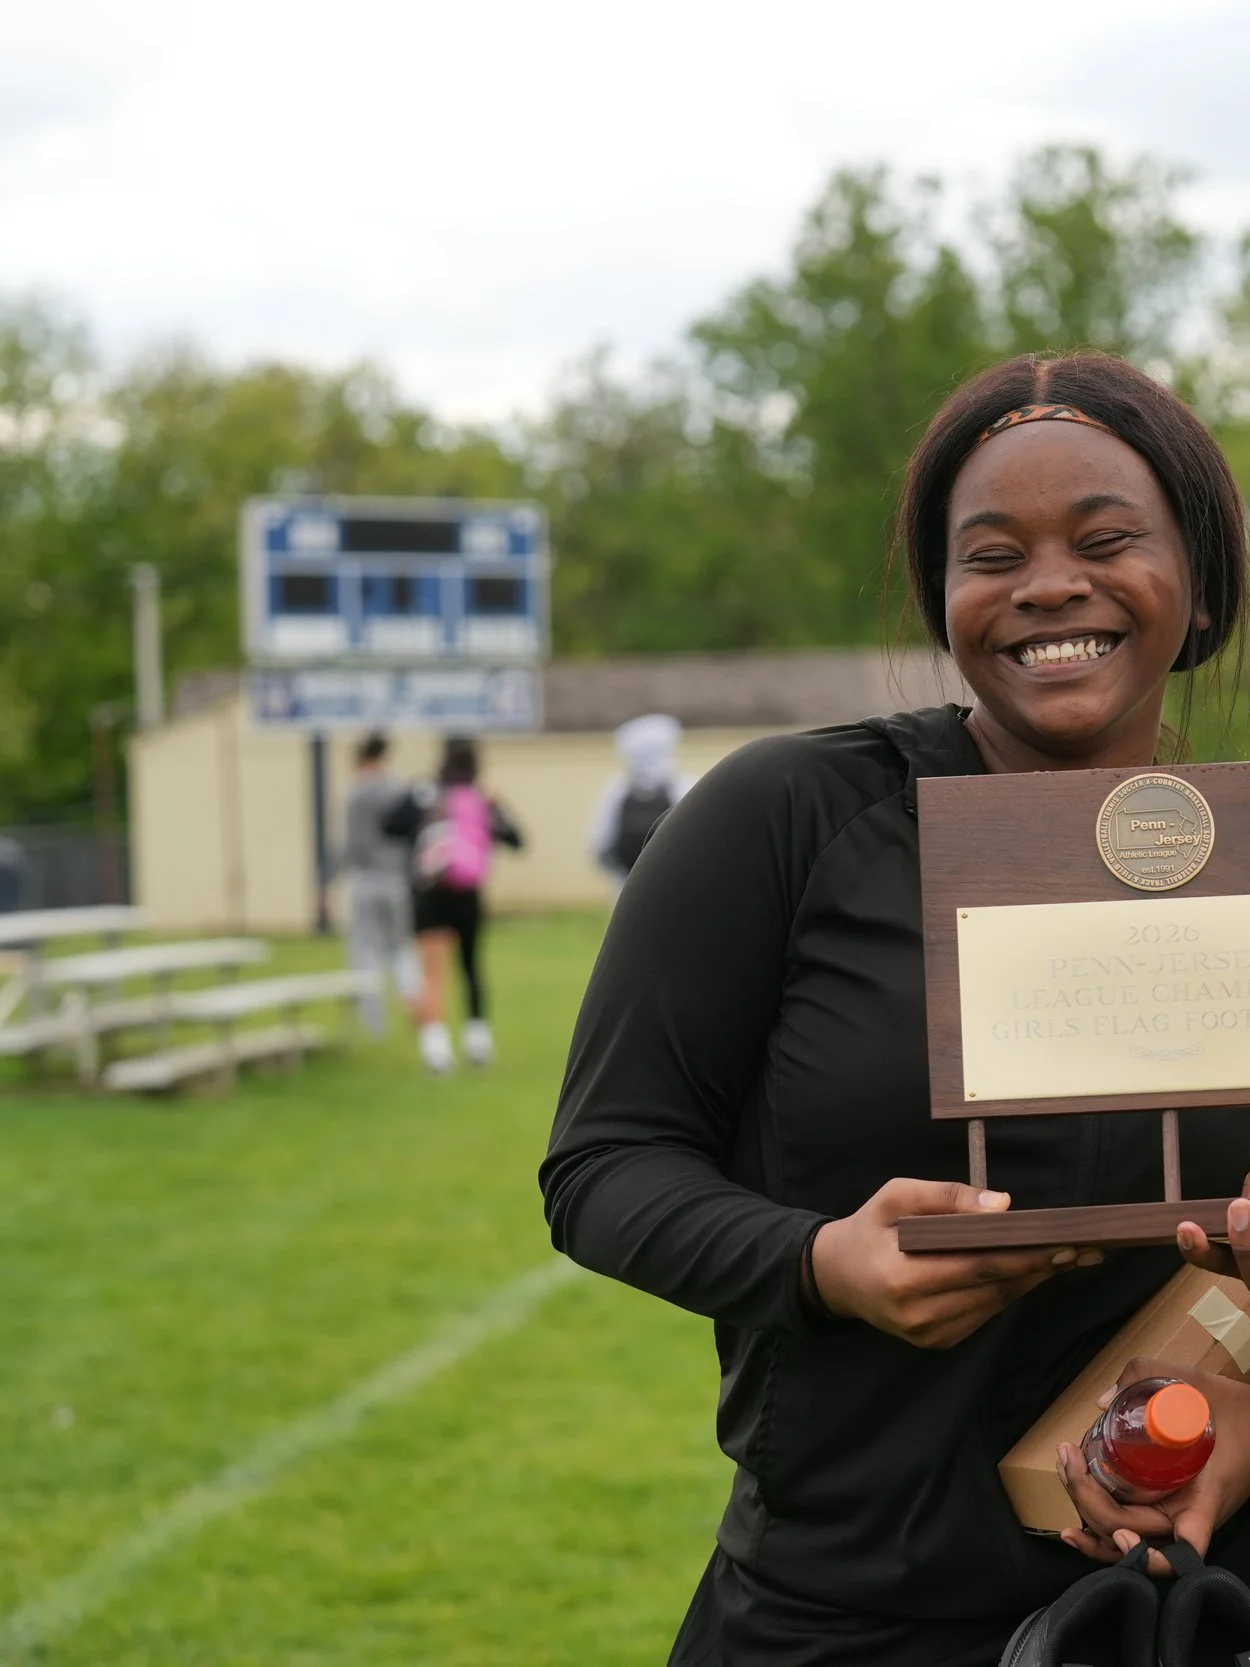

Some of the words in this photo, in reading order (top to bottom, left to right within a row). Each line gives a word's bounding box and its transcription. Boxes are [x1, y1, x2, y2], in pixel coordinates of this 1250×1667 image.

[1118, 779, 1144, 798] SOCCER
[1146, 777, 1185, 791] X-COUNTRY
[1103, 796, 1119, 820] TENNIS
[1185, 789, 1210, 827] BASKETBALL
[1131, 820, 1166, 831] Penn
[1101, 822, 1116, 863] VOLLEYBALL
[1155, 834, 1201, 846] Jersey
[1197, 830, 1210, 864] SOFTBALL
[1120, 850, 1148, 859] Athletic
[1149, 850, 1177, 859] League
[1113, 863, 1132, 880] FIELD
[1139, 878, 1165, 887] TRACK
[1166, 864, 1198, 886] BASEBALL
[1123, 923, 1200, 946] 2026
[1012, 984, 1140, 1010] LEAGUE
[992, 1017, 1080, 1040] GIRLS
[1092, 1013, 1170, 1035] FLAG
